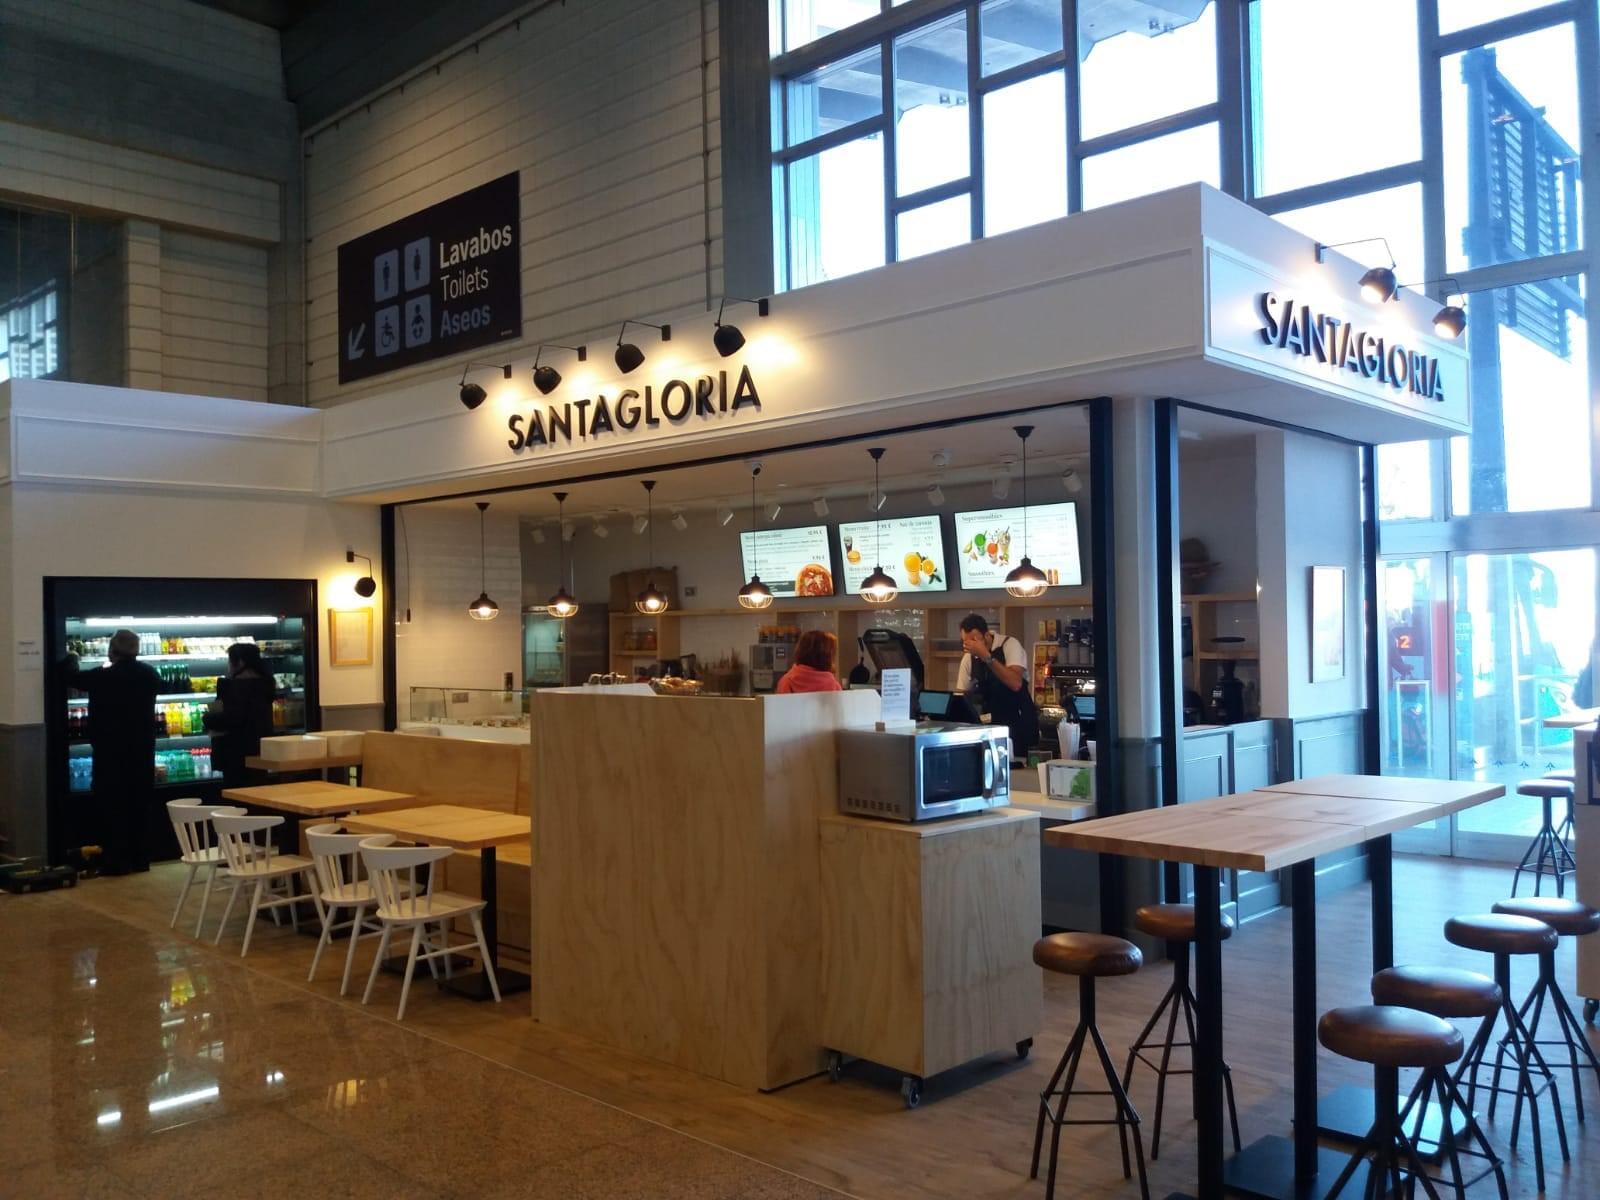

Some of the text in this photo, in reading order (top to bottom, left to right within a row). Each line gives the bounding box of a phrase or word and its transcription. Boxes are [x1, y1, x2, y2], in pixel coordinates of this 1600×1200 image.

[440, 225, 512, 269] Lavabos
[440, 266, 489, 301] Toilets
[440, 305, 491, 338] Aseos
[1260, 291, 1445, 401] SANTAGLORIA
[508, 364, 762, 450] SANTAGLORIA
